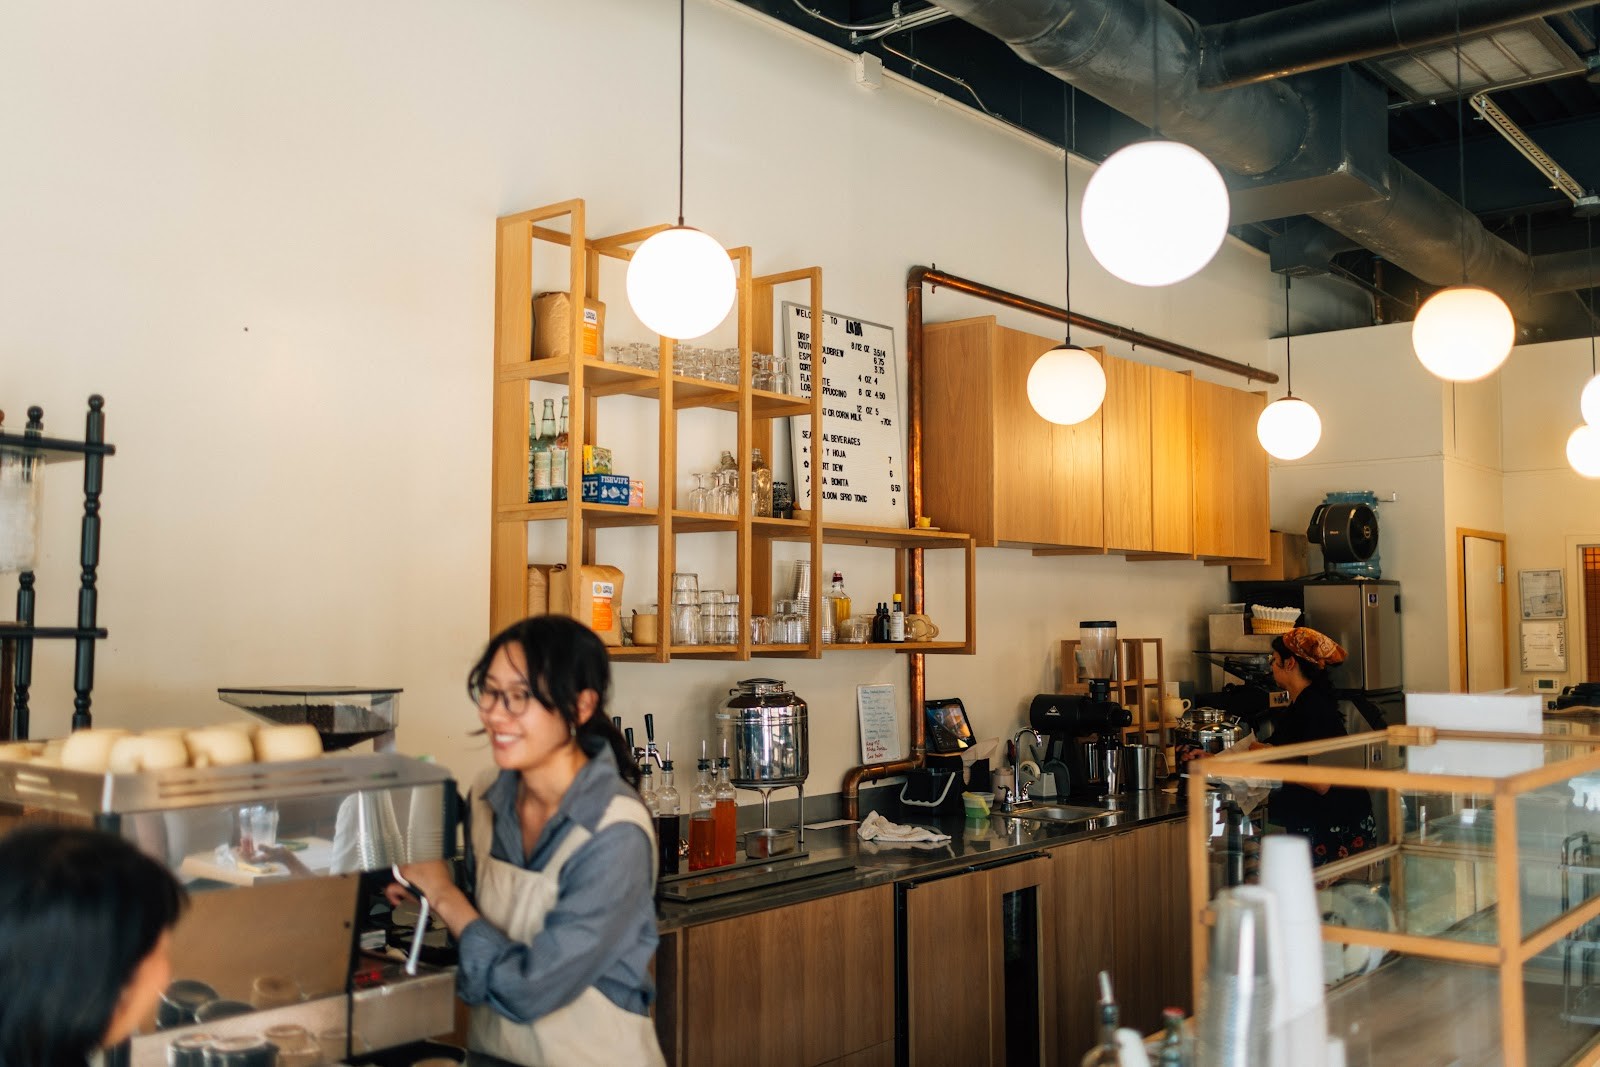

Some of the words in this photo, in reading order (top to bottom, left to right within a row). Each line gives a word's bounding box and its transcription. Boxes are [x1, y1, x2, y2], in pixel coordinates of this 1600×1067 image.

[796, 308, 824, 322] WELCE
[798, 332, 809, 340] DRIP
[822, 346, 844, 357] OLDBREW
[800, 363, 811, 371] CORT
[801, 383, 811, 391] LOB
[822, 387, 847, 398] PPUCCINO
[857, 405, 862, 413] 12
[866, 407, 872, 415] OZ
[802, 430, 829, 442] SEAAL
[831, 434, 860, 446] BEVERAGES
[826, 449, 830, 457] Y
[833, 450, 846, 458] HOJA
[832, 463, 843, 472] DEW
[601, 476, 628, 484] FISHWIFE
[831, 478, 848, 487] BONITA
